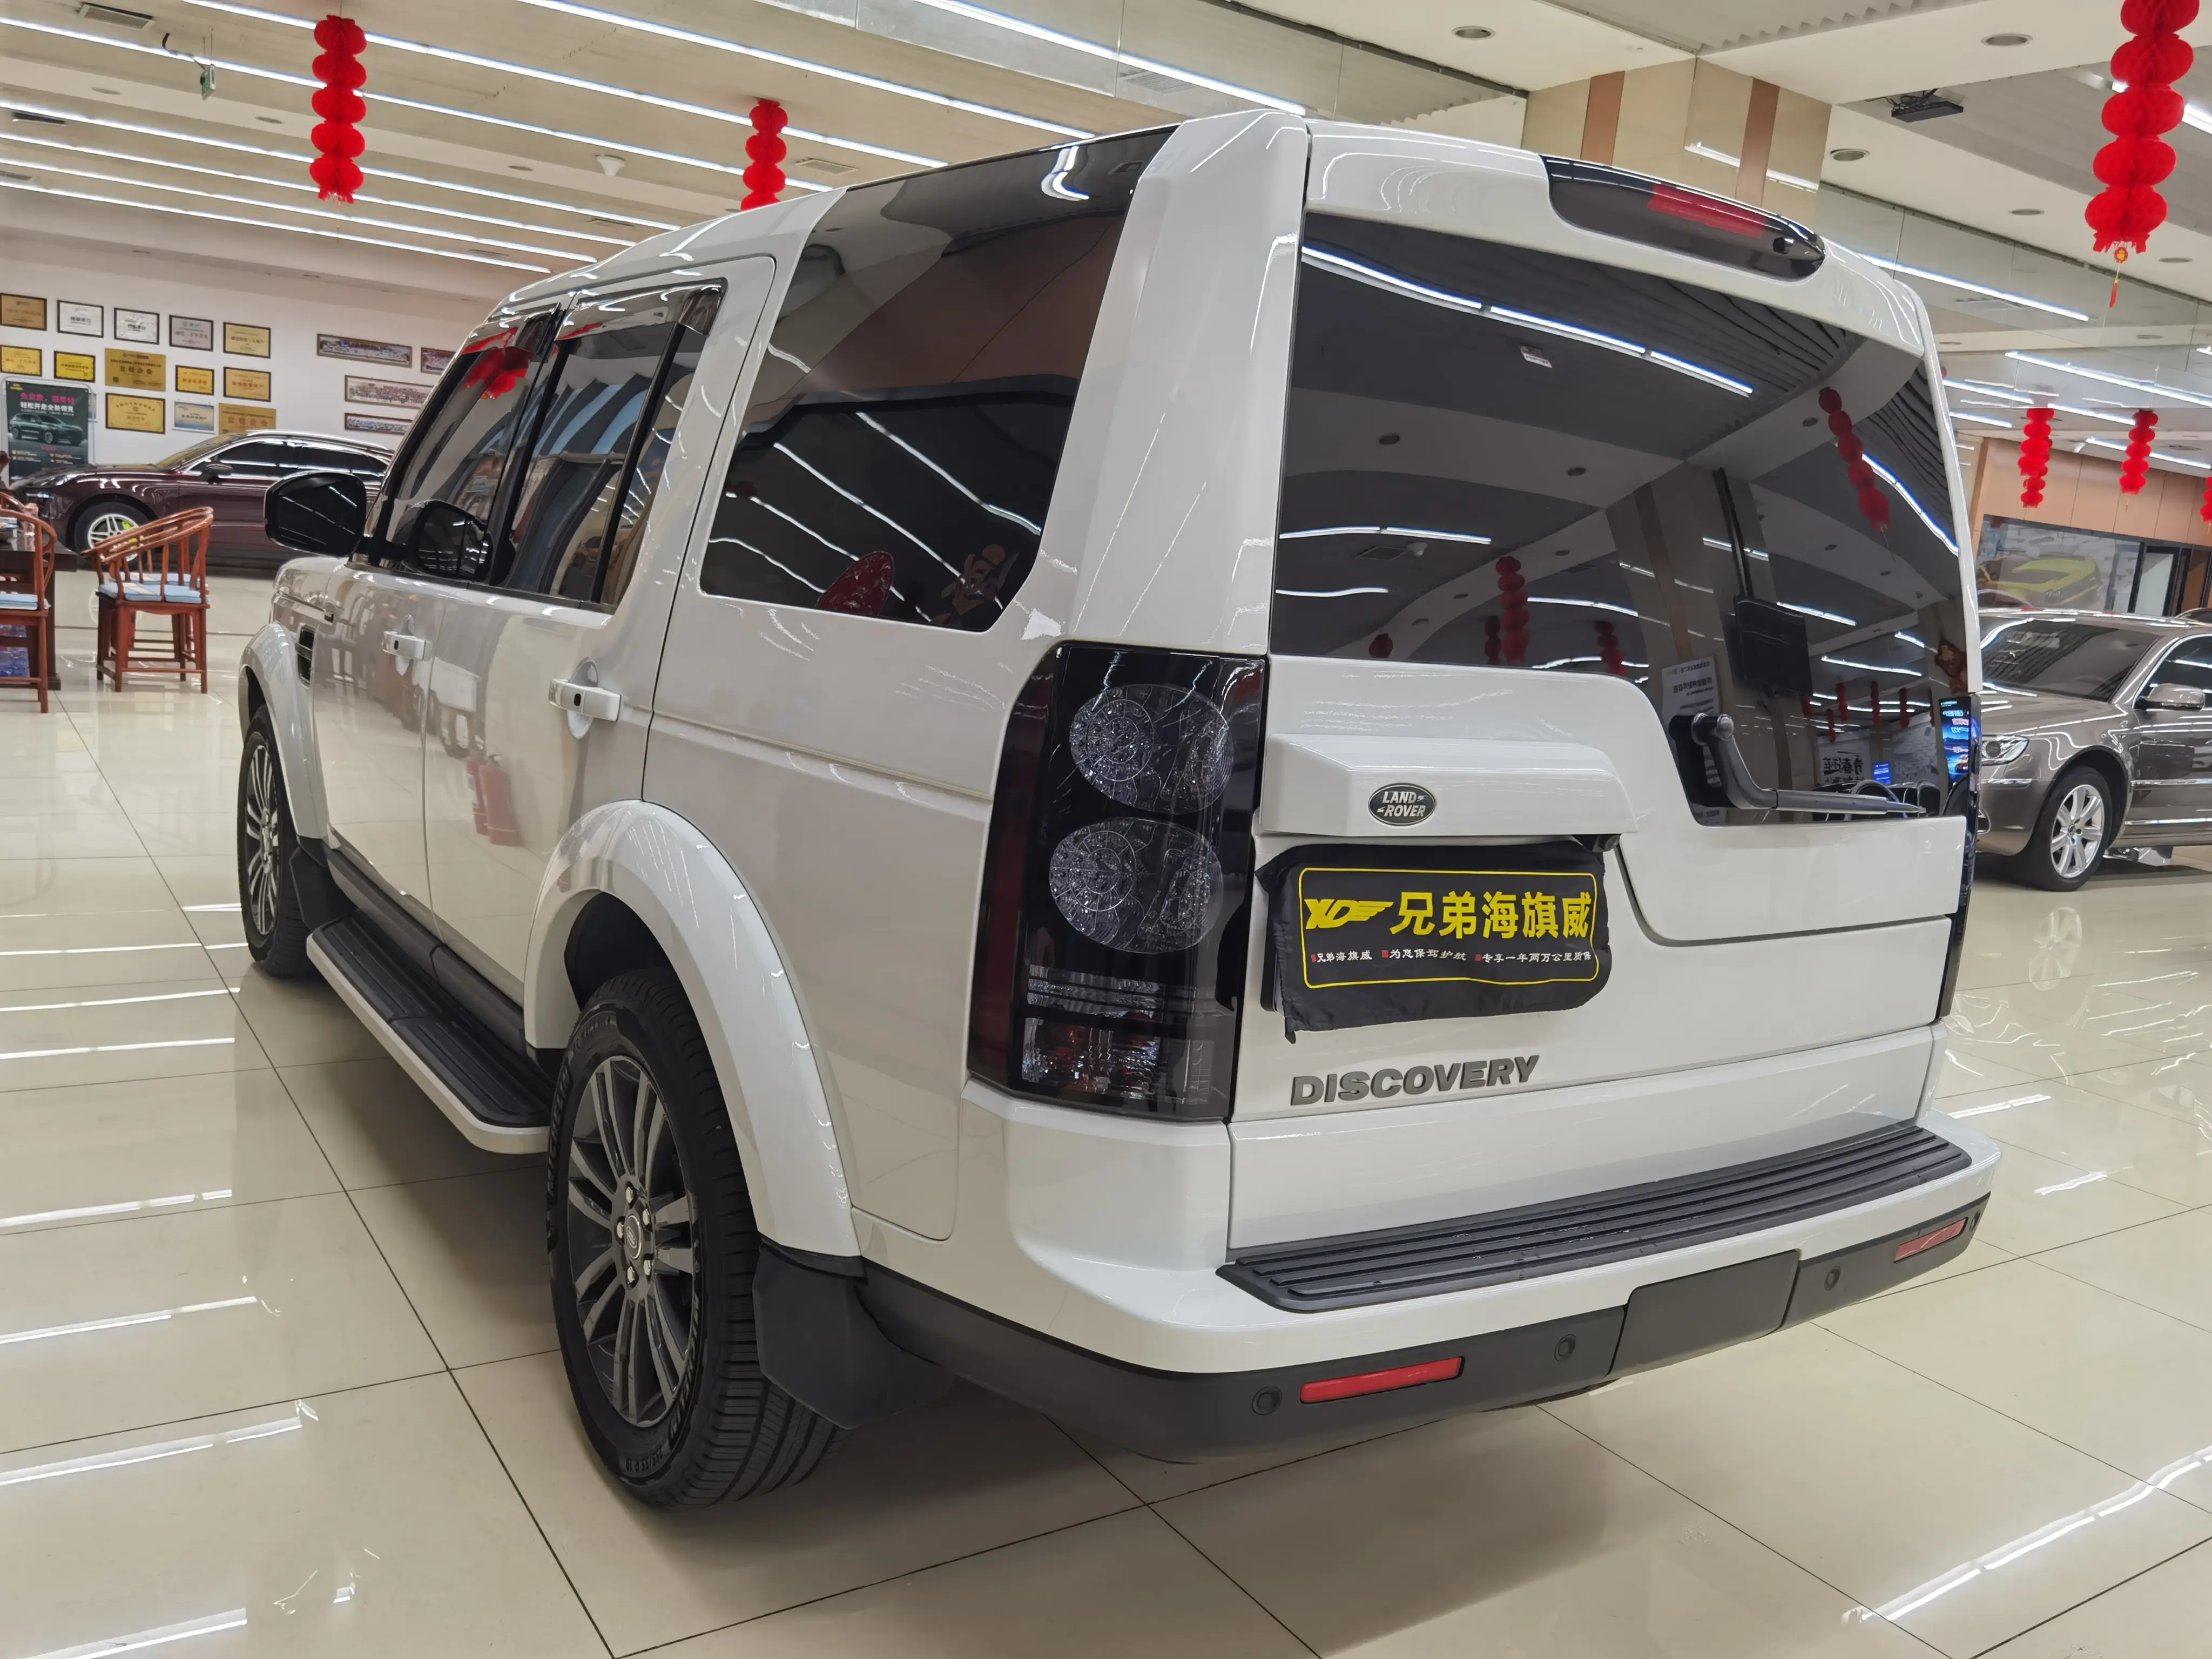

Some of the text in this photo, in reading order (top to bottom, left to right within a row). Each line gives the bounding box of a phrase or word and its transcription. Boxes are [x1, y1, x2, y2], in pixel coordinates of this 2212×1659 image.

[1382, 791, 1417, 803] LAND
[1384, 805, 1426, 817] ROVER
[1390, 891, 1591, 939] 兄弟海旗威
[1317, 948, 1591, 963] 兄弟海旗威 为您保驾护航 专享一年两万公里质保
[1290, 1055, 1540, 1105] DISCOVERY
